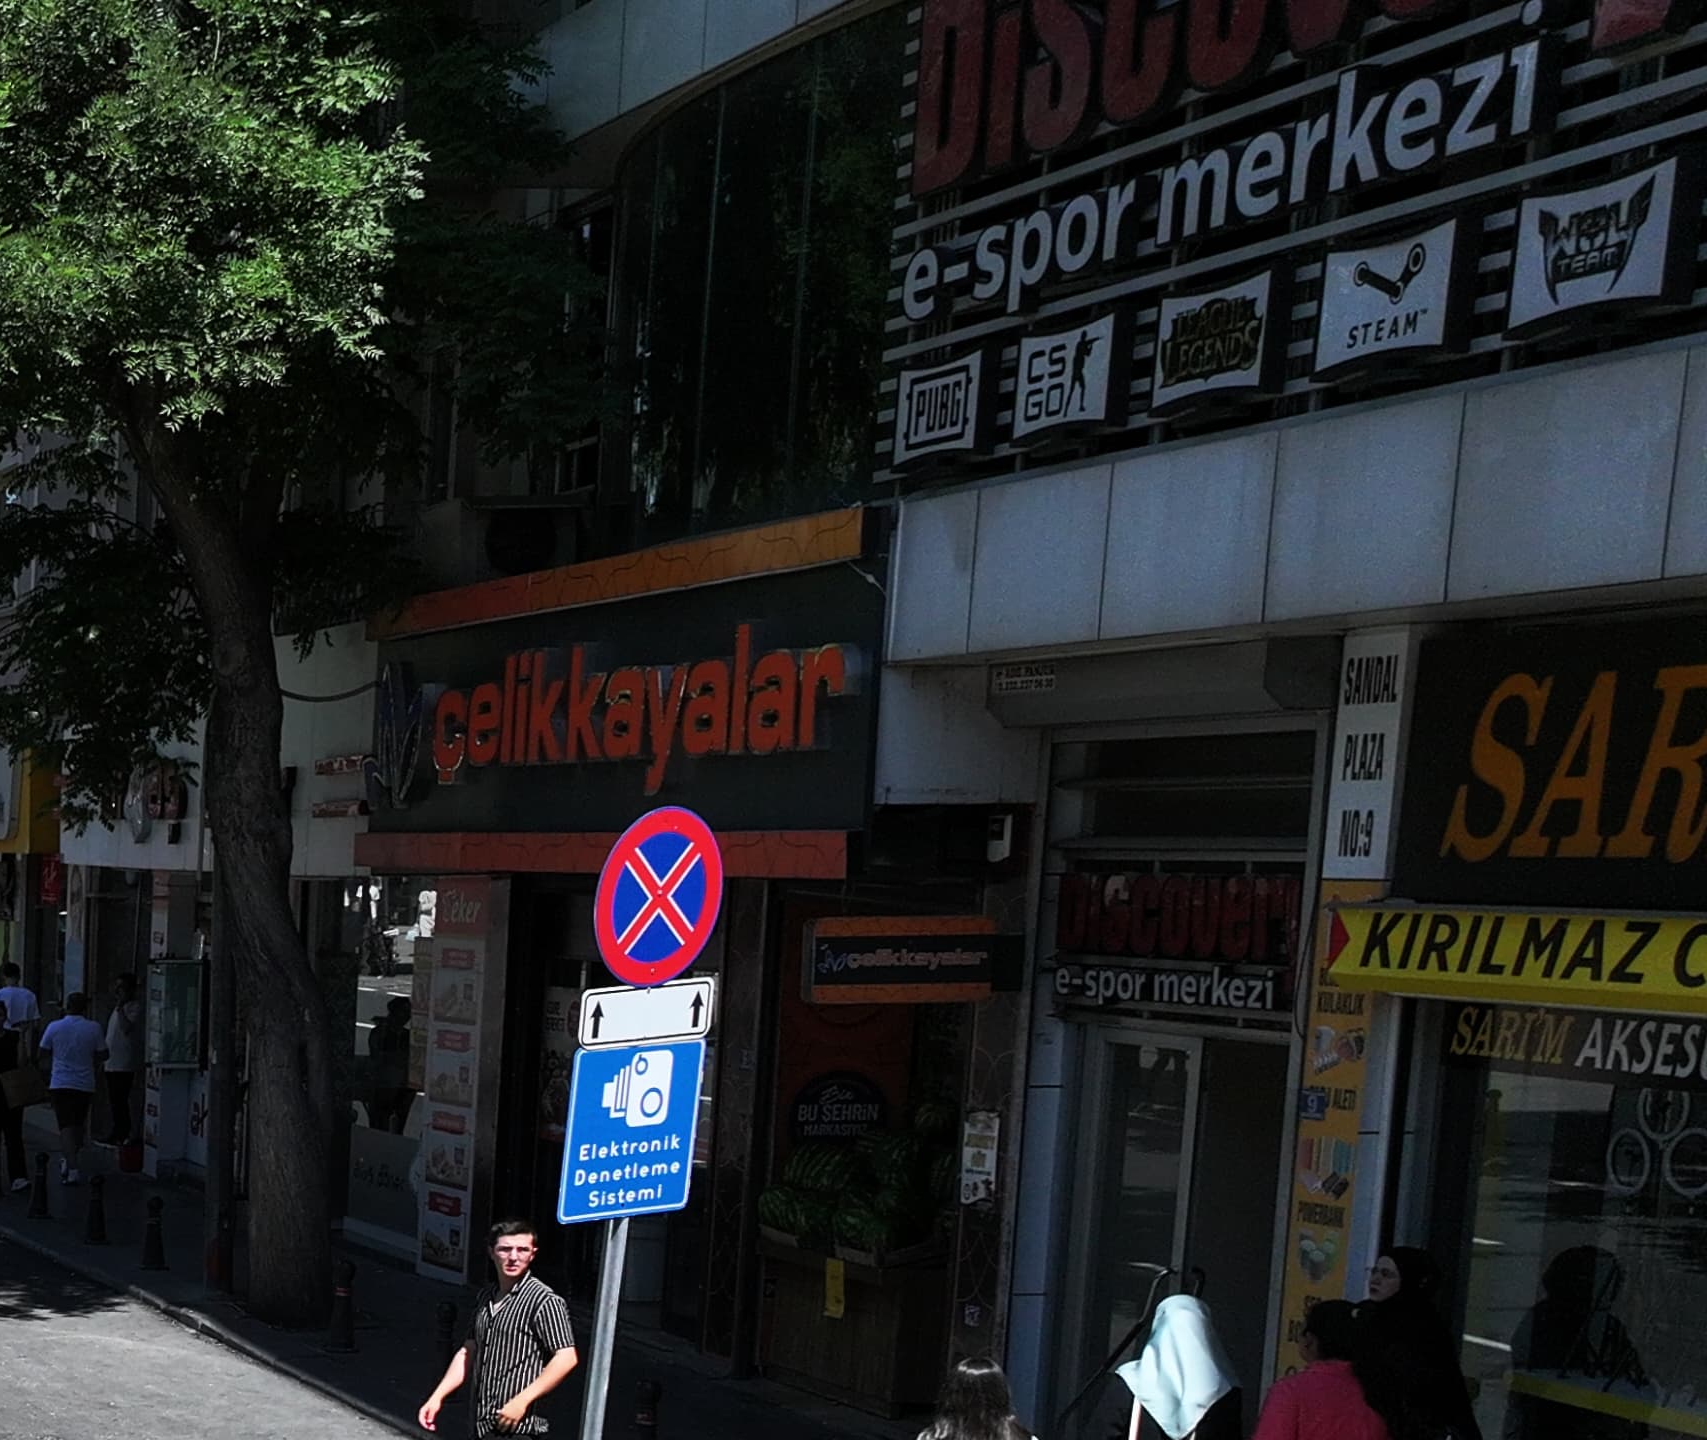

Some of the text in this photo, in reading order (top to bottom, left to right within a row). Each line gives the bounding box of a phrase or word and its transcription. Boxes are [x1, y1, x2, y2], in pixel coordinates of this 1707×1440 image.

[902, 0, 1542, 322] e-spor merkezi
[1555, 246, 1619, 276] TEAM
[1163, 318, 1259, 386] LEGENDS
[1347, 312, 1419, 348] STEAM
[1027, 346, 1067, 385] CS
[915, 374, 964, 431] PUBG
[1023, 387, 1064, 422] GO
[1344, 654, 1399, 706] SANDAL
[433, 623, 845, 795] çelikkayalar
[1342, 732, 1385, 783] PLAZA
[1338, 810, 1374, 859] NO:9
[1359, 911, 1662, 986] KIRILMAZ
[1055, 966, 1147, 1005] e-spor
[1154, 964, 1275, 1010] merkezi
[1450, 1004, 1576, 1065] SARI'M
[797, 1104, 819, 1122] BU
[1306, 1094, 1319, 1114] 9
[578, 1133, 681, 1162] Elektronik
[573, 1158, 681, 1187] Denetleme
[588, 1184, 663, 1208] Sistemi
